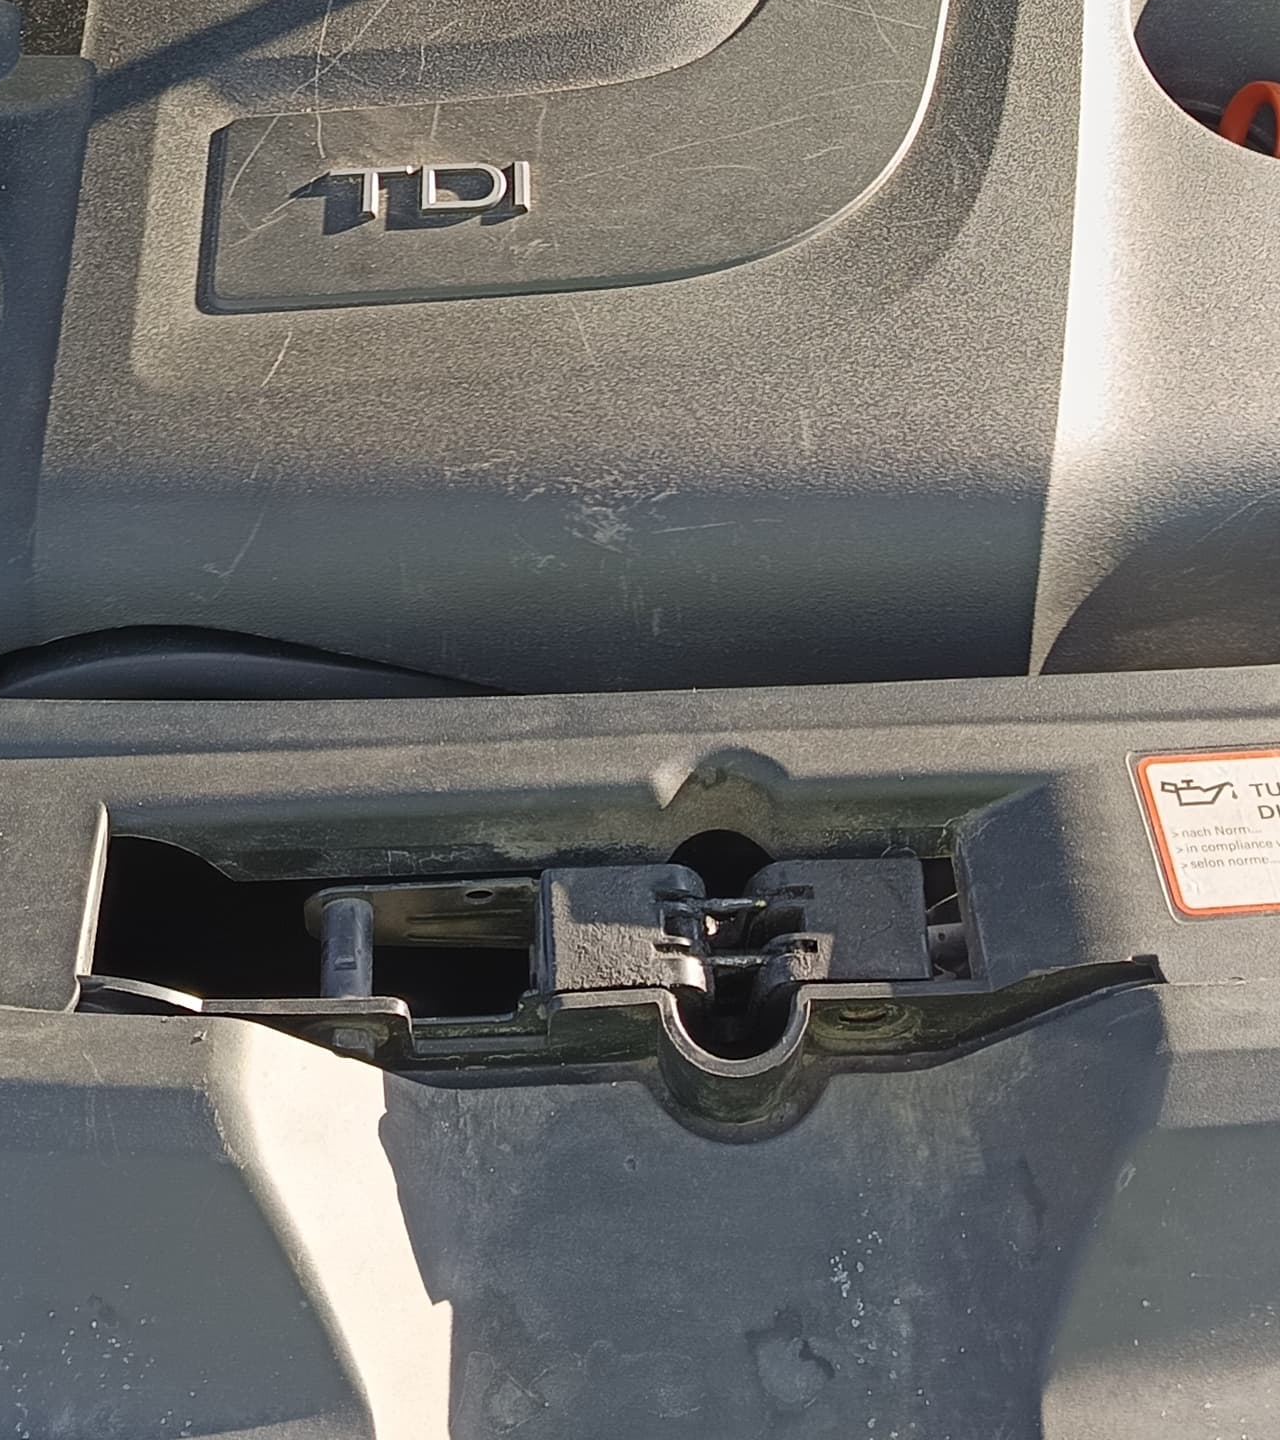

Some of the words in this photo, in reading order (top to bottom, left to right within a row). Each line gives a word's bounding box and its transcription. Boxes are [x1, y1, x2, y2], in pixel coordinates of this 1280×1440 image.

[328, 161, 530, 220] TDI
[1181, 826, 1212, 839] nach
[1185, 843, 1198, 854] in
[1201, 839, 1273, 855] compliance
[1190, 858, 1223, 870] selon
